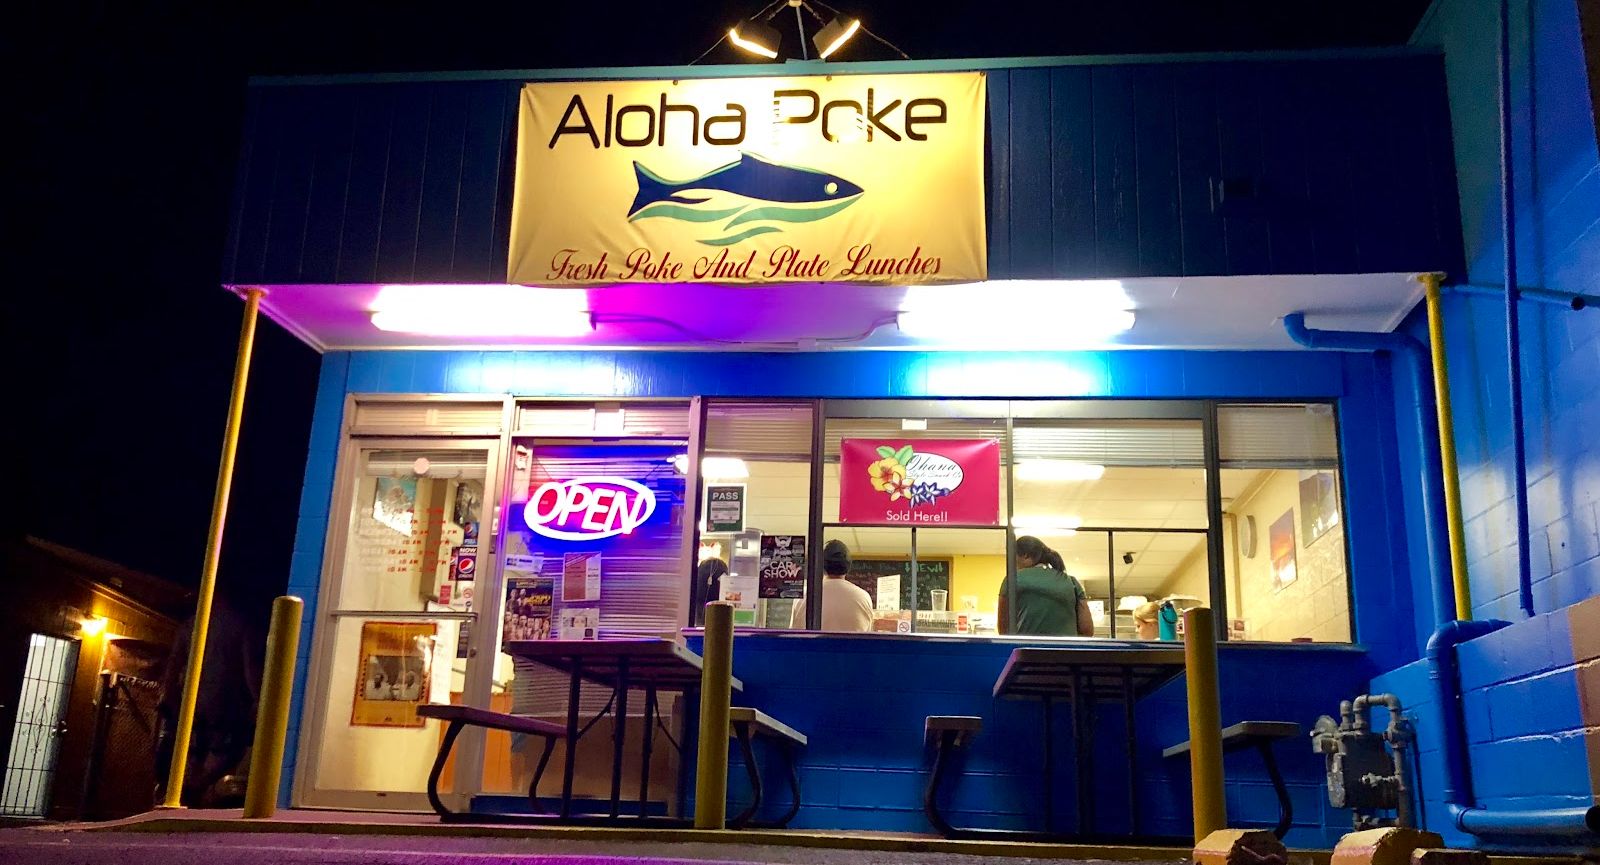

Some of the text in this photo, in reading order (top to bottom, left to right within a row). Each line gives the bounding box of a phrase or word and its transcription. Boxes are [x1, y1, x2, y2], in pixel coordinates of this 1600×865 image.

[548, 87, 947, 149] Aloha Poke
[546, 243, 941, 280] Fresh Poke And Plate Lunches
[908, 454, 956, 471] Ohana
[712, 491, 739, 500] PASS
[533, 482, 646, 535] OPEN
[886, 510, 910, 522] Sold
[770, 561, 793, 570] CAR
[763, 569, 799, 579] SHOW
